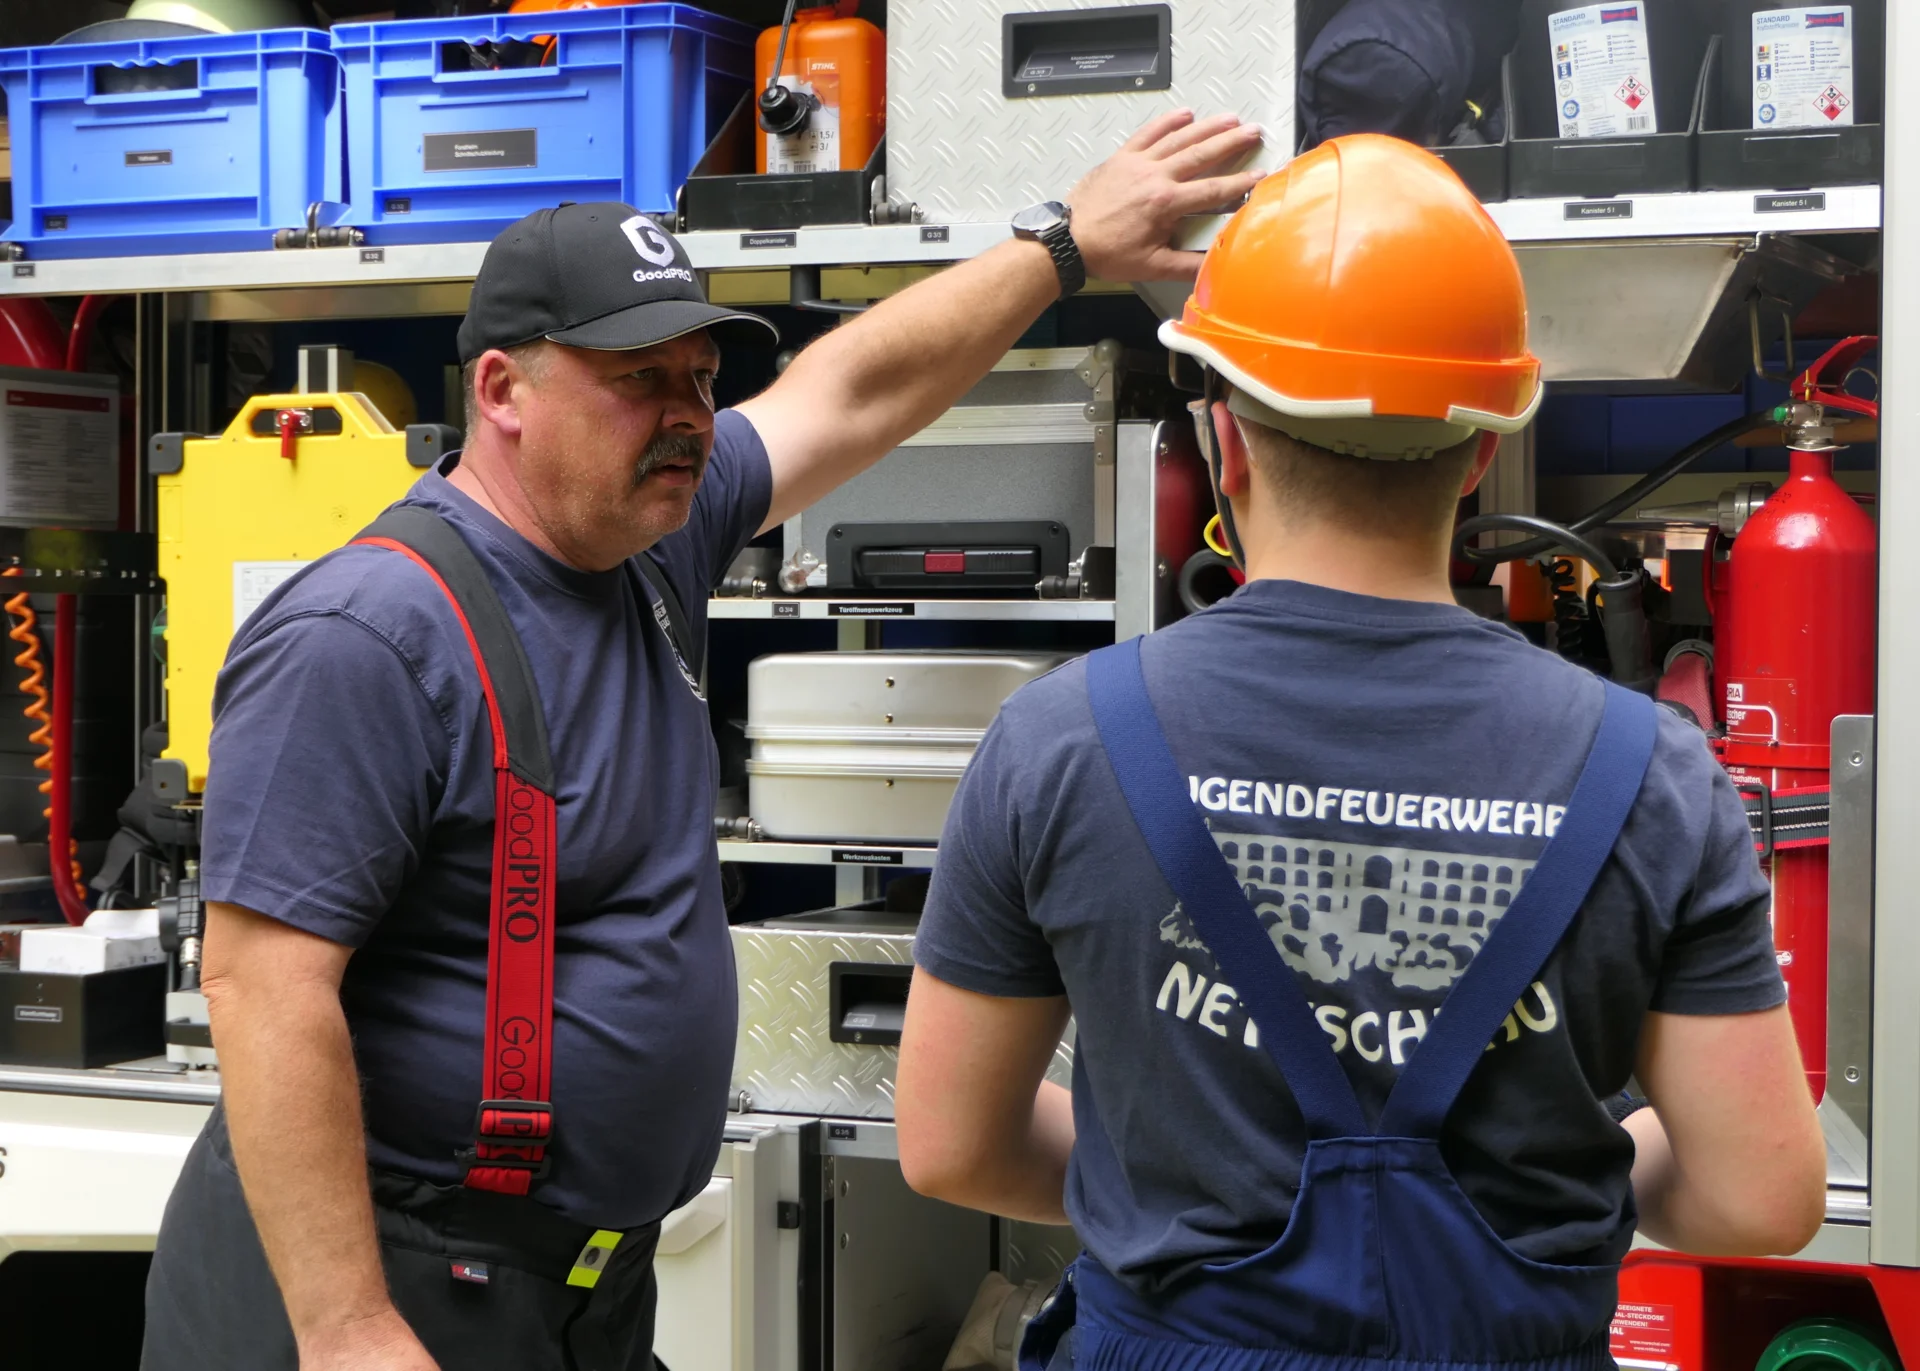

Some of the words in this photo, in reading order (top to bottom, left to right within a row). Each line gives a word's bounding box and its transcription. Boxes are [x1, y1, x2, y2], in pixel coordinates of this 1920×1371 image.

[1552, 13, 1586, 26] STANDARD
[1756, 15, 1790, 25] STANDARD
[1772, 200, 1797, 208] Kanister
[1581, 206, 1605, 215] Kanister
[749, 238, 787, 247] Doppelkanister
[632, 267, 693, 282] GoodPRO
[842, 853, 891, 861] Werkzeugkasten
[1617, 1304, 1653, 1312] GEEIGNETE
